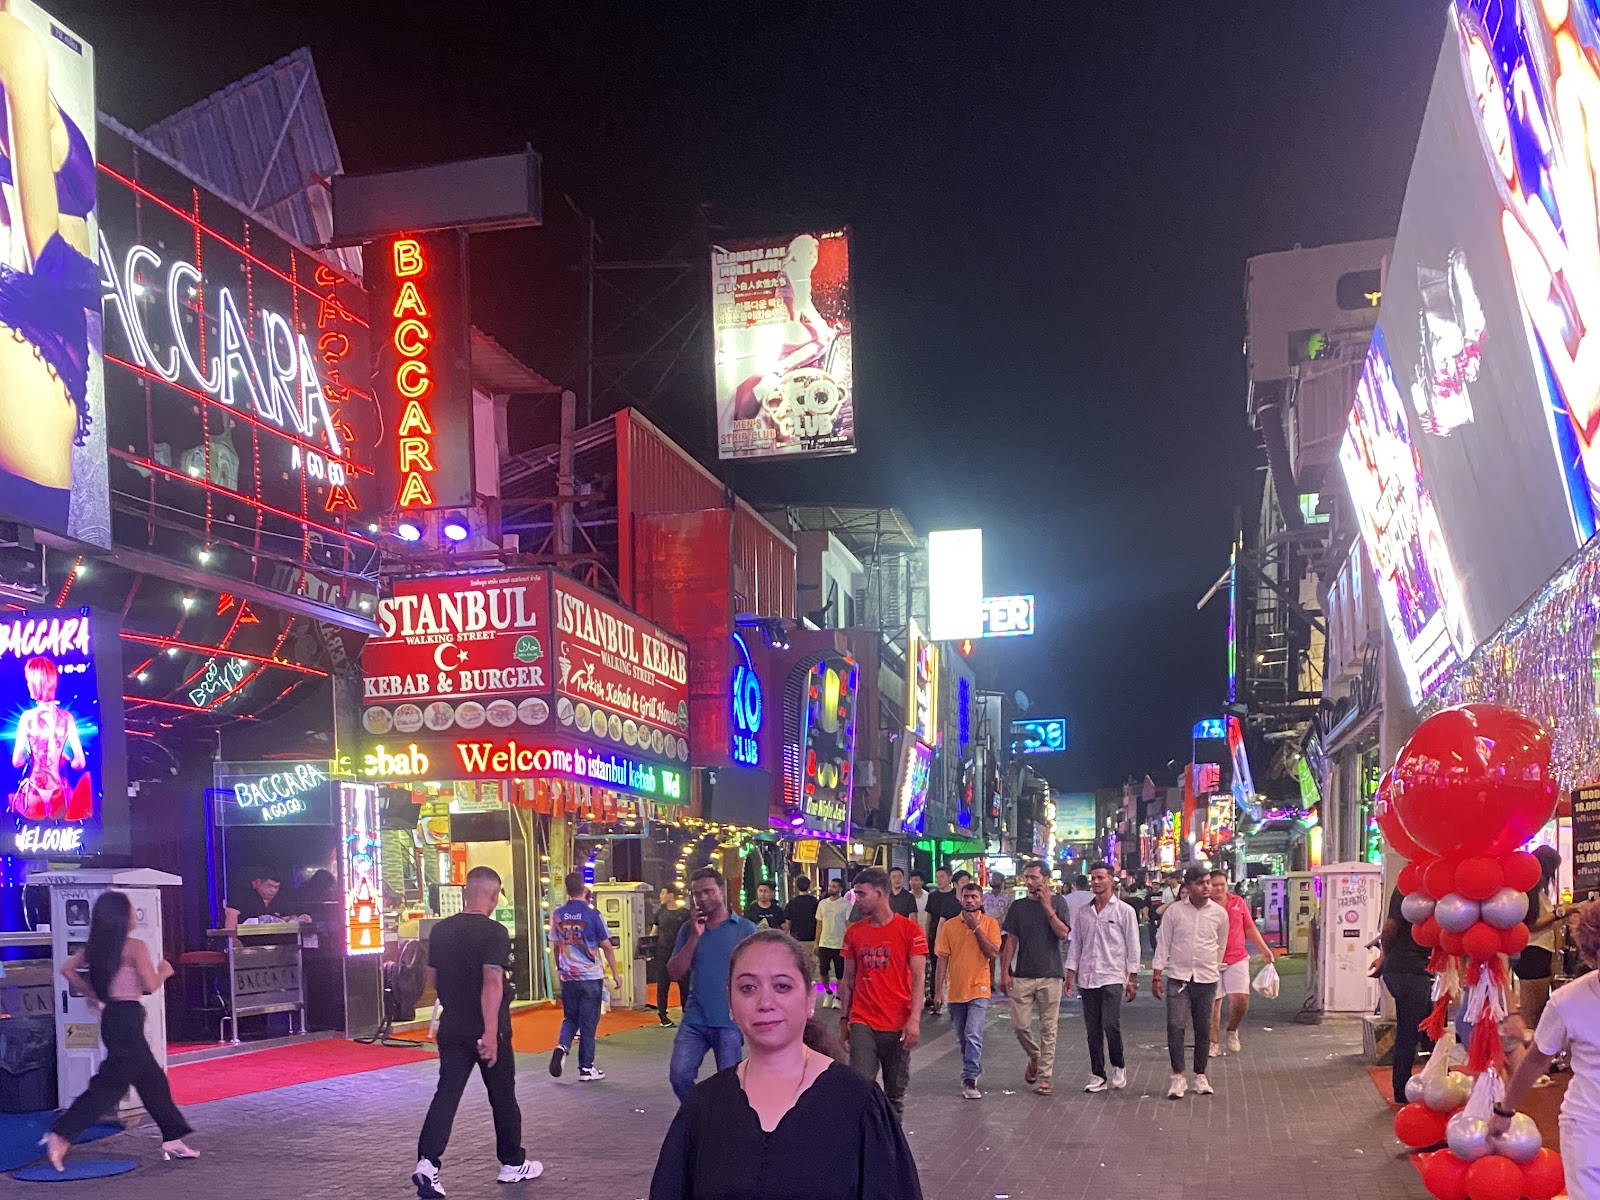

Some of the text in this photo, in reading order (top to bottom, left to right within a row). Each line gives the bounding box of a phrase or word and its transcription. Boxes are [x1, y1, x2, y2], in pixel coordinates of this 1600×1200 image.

[393, 240, 434, 507] BACCARA
[720, 428, 777, 445] STRIP CLUB
[780, 412, 833, 438] CLUB
[307, 451, 324, 480] GO
[328, 460, 345, 486] GO
[370, 587, 538, 638] STANBUL
[0, 616, 91, 659] BACCARA
[405, 630, 497, 645] WALKING STREET
[555, 589, 687, 685] ISTANBUL KEBAB
[363, 666, 545, 698] KEBAB & BURGER
[600, 650, 656, 687] WALKING STREET
[570, 666, 605, 700] Turkish
[606, 682, 632, 710] Kebab
[632, 692, 639, 712] &
[640, 695, 657, 720] Grill
[657, 700, 678, 727] House
[733, 665, 762, 733] KO
[358, 744, 430, 776] ebab
[457, 741, 572, 773] Welcome
[574, 748, 586, 777] to
[588, 748, 627, 786] istanbul
[629, 761, 657, 792] kebab
[234, 763, 327, 808] BACCARA
[15, 825, 84, 852] WELCOME
[564, 912, 582, 920] Staff
[237, 969, 298, 990] BACCARA
